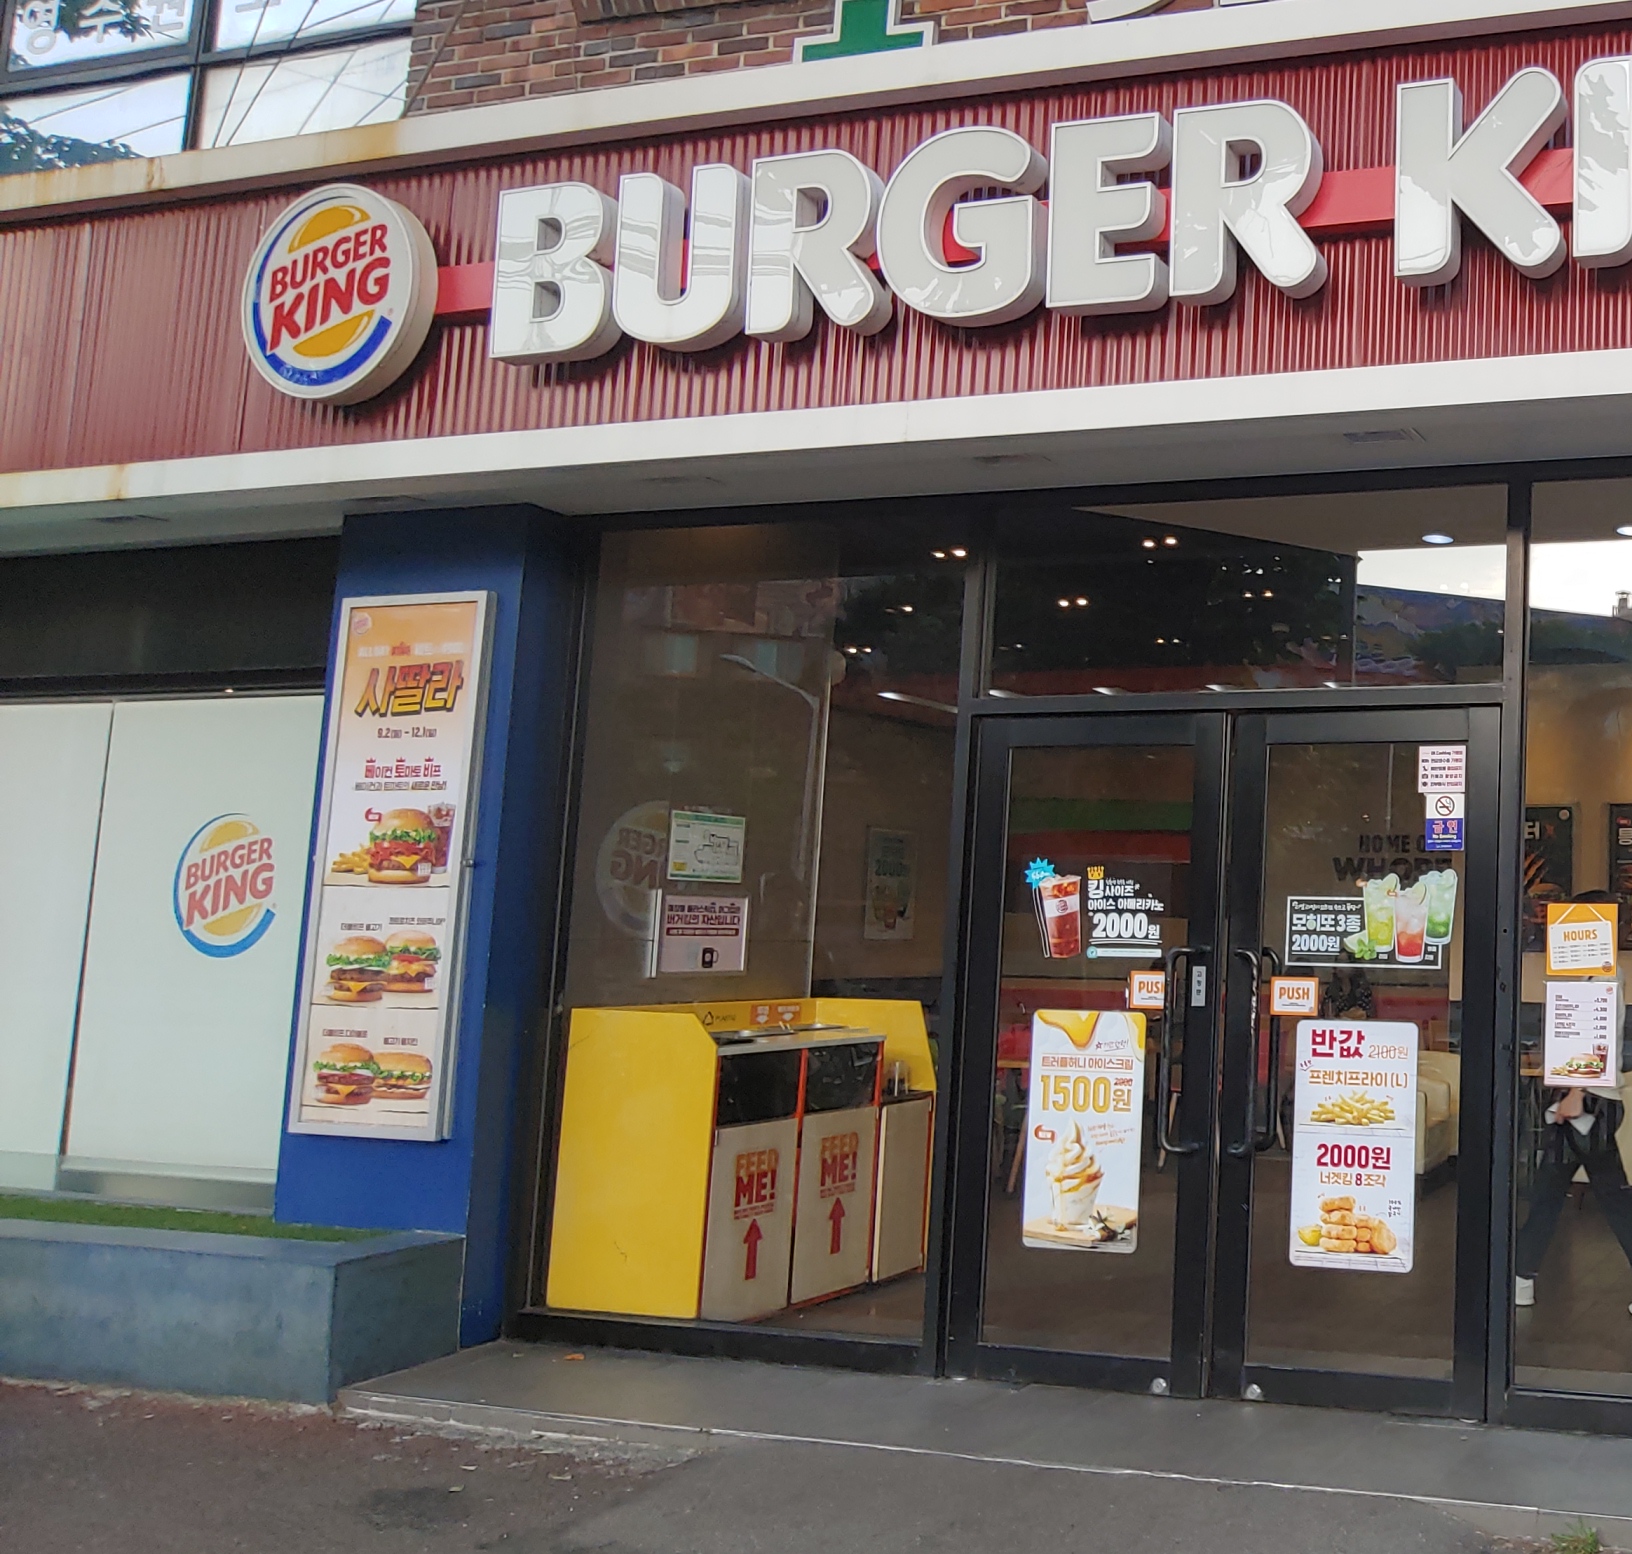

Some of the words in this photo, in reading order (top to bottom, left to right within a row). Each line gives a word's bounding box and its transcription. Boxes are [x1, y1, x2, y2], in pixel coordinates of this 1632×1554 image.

[489, 99, 1327, 365] BURGER
[269, 224, 388, 304] BURGER
[269, 256, 391, 352] KING
[395, 763, 422, 778] 토마토
[423, 763, 441, 777] 비프
[1432, 820, 1459, 834] 금연
[1358, 834, 1411, 854] HOME
[185, 837, 273, 891] BURGER
[185, 862, 275, 928] KING
[1088, 898, 1116, 911] 아이스
[1117, 898, 1164, 912] 아메리카노
[1092, 912, 1160, 939] 2000원
[1291, 913, 1335, 932] 모히또
[1336, 913, 1361, 932] 3종
[1291, 934, 1340, 952] 2000원
[1563, 929, 1598, 943] HOURS
[1278, 986, 1310, 1000] PUSH
[1311, 1028, 1365, 1060] 반값
[1042, 1055, 1086, 1069] 트러플허니
[1088, 1056, 1134, 1071] 아이스크림
[1308, 1069, 1388, 1088] 프렌치프라이
[1390, 1072, 1409, 1089] (L)
[1041, 1074, 1132, 1113] 1500원
[1316, 1143, 1391, 1171] 2000원
[820, 1152, 858, 1187] ME!
[1319, 1171, 1353, 1187] 너겟킹
[734, 1169, 778, 1207] ME!
